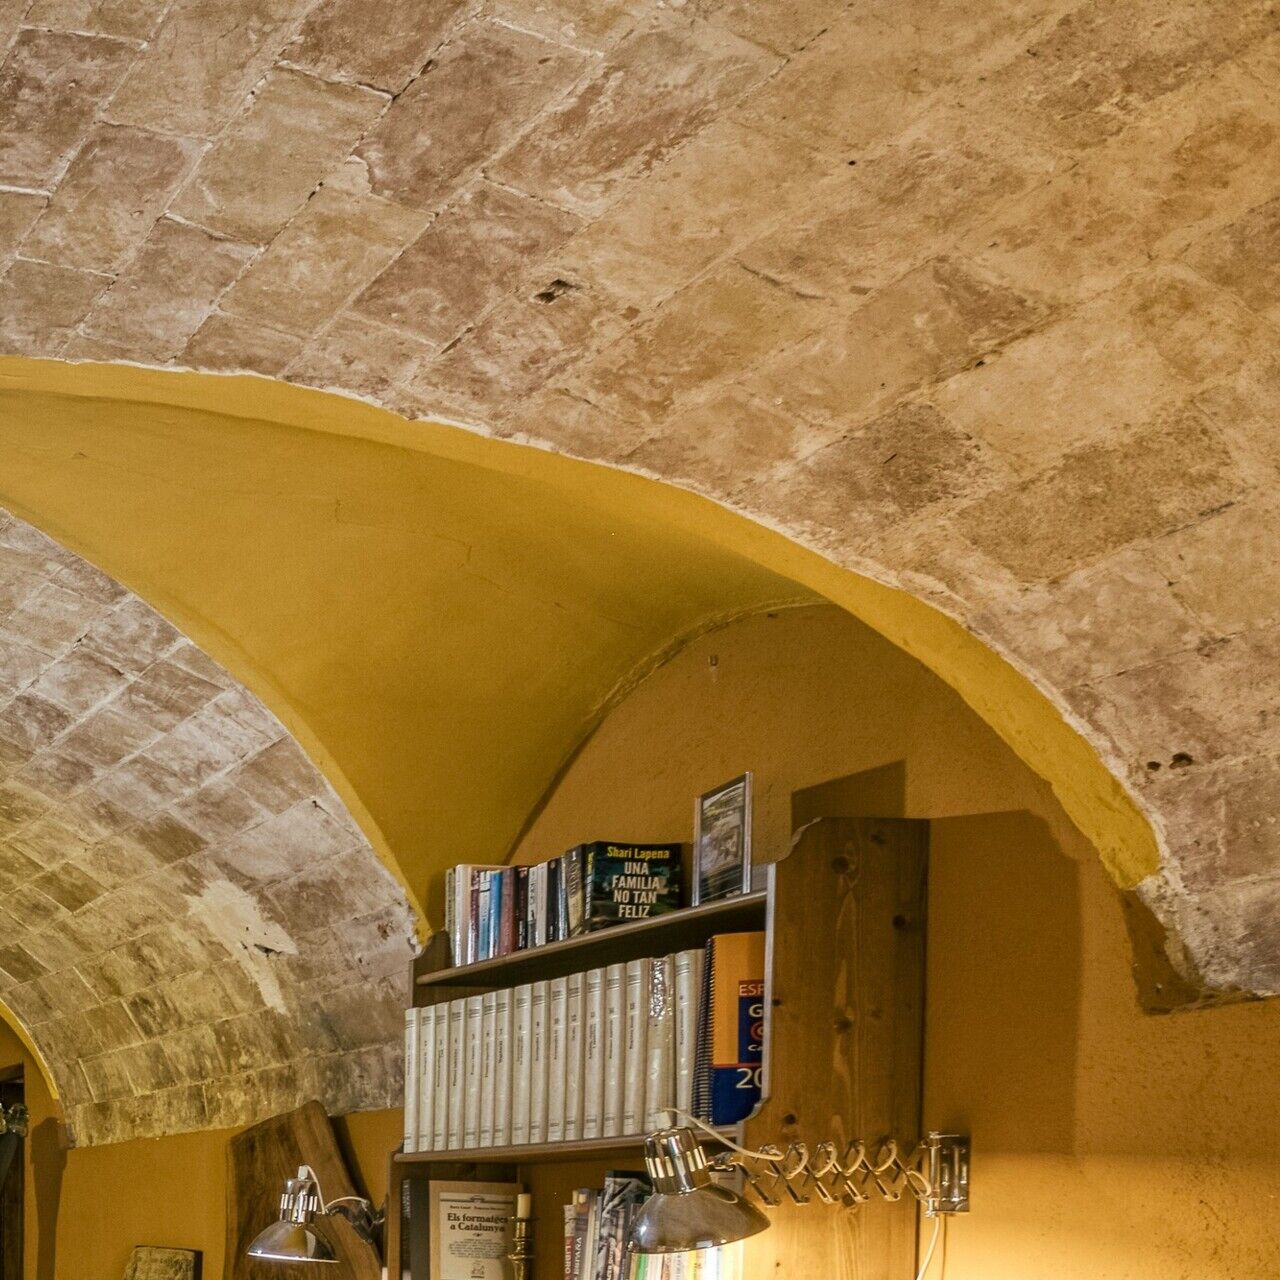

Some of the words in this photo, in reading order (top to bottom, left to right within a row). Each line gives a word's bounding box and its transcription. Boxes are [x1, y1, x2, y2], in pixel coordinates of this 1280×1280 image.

[607, 846, 632, 858] Shari
[634, 848, 670, 861] Lapena
[624, 862, 649, 875] UNA
[611, 875, 660, 889] FAMILIA
[613, 891, 630, 903] NO
[633, 891, 657, 904] TAN
[618, 905, 651, 918] FELIZ
[447, 1213, 461, 1222] Els
[462, 1213, 509, 1225] formatges
[458, 1222, 505, 1233] Catalunya
